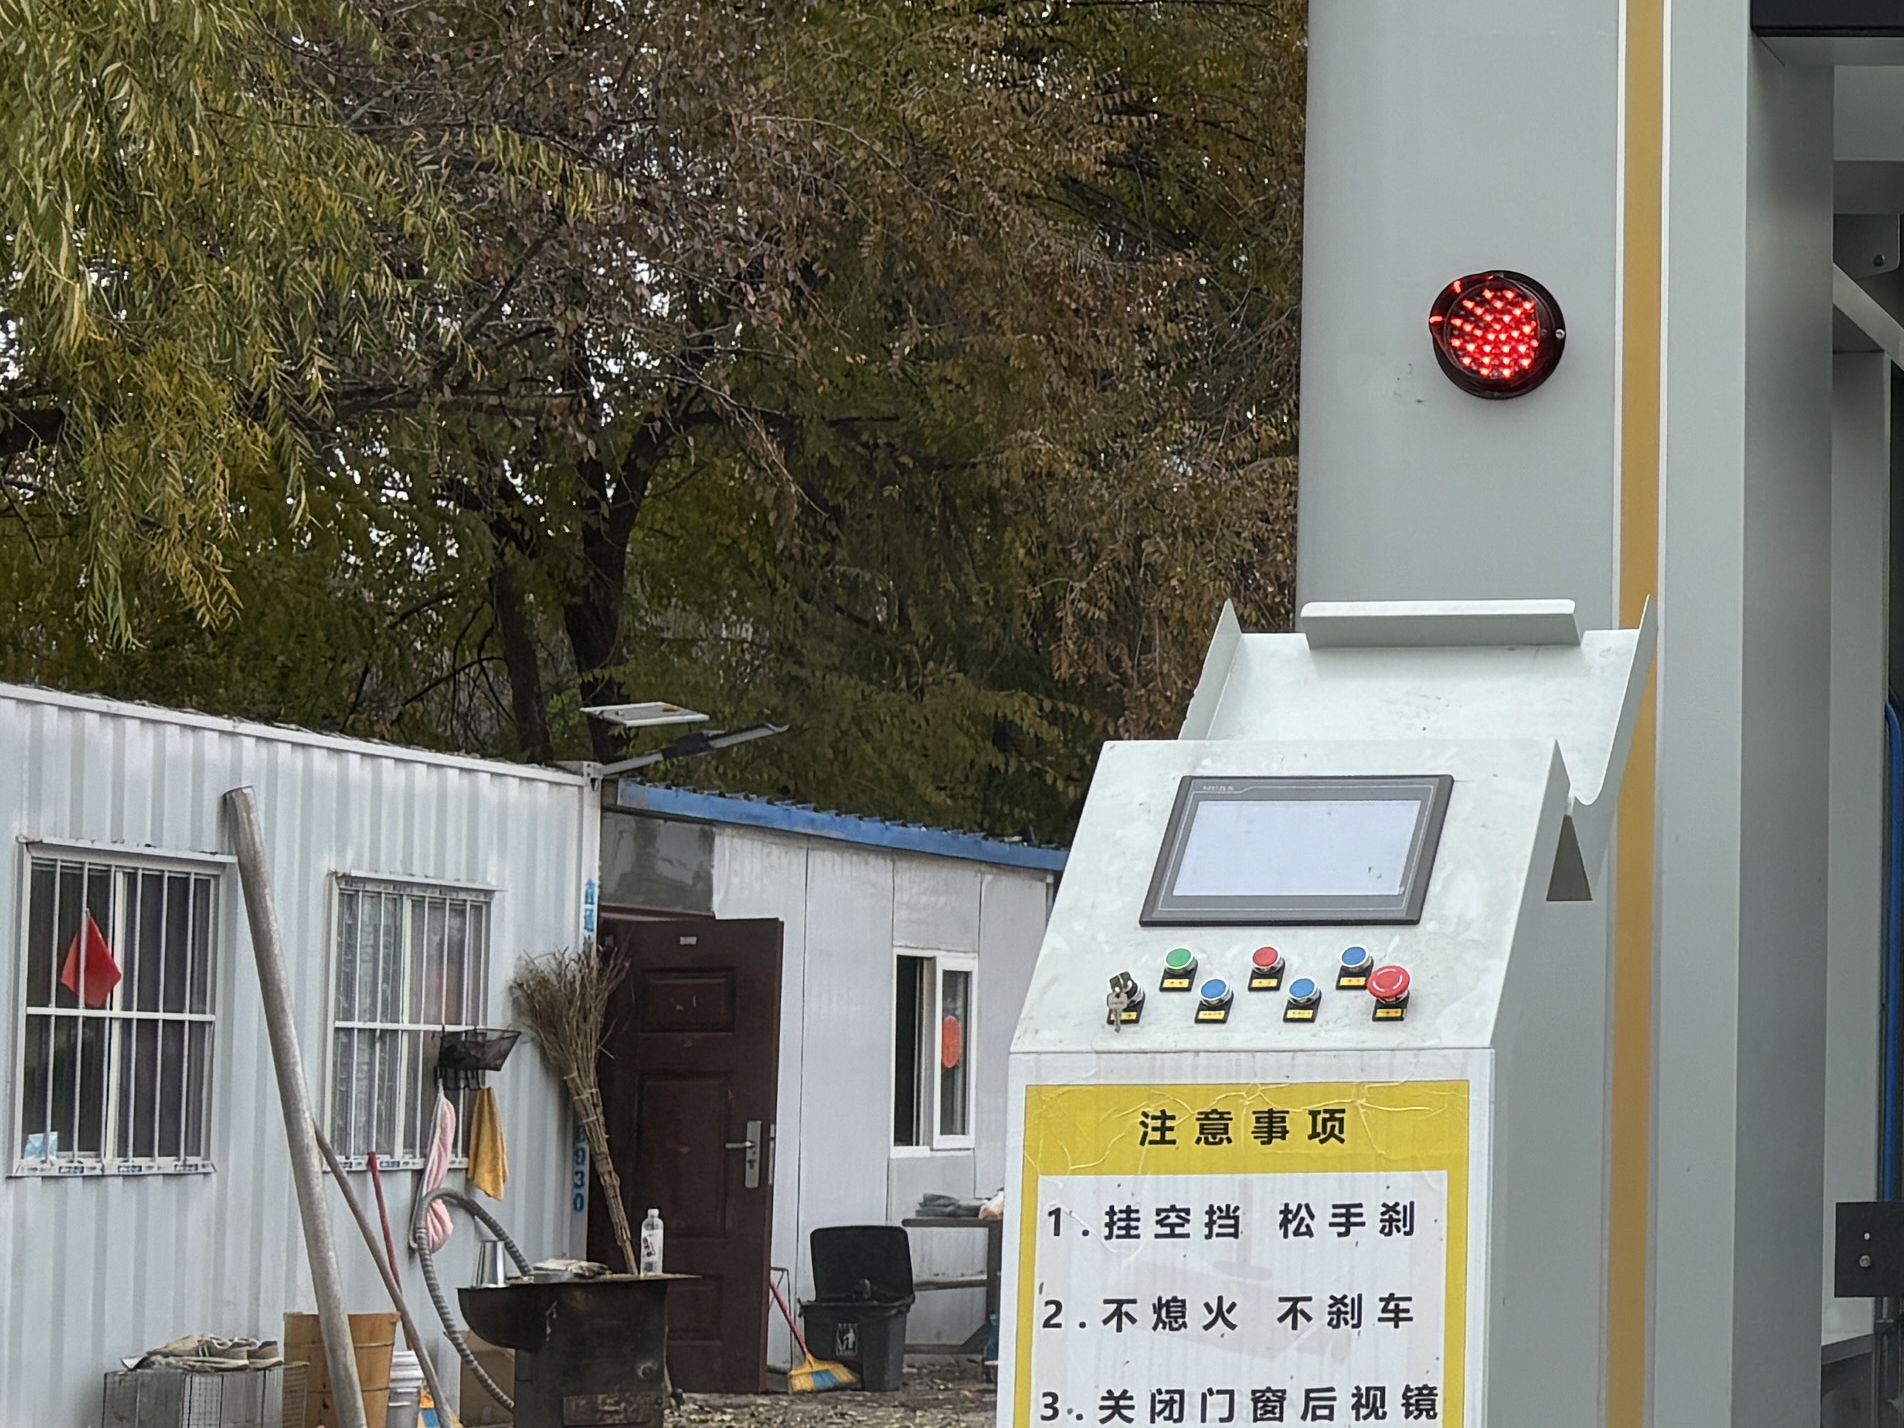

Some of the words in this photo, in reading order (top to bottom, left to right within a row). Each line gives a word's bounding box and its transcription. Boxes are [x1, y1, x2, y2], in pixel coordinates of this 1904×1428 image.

[1139, 1107, 1346, 1147] 注意事项
[1040, 1383, 1439, 1425] 3.关闭门窗后视镜
